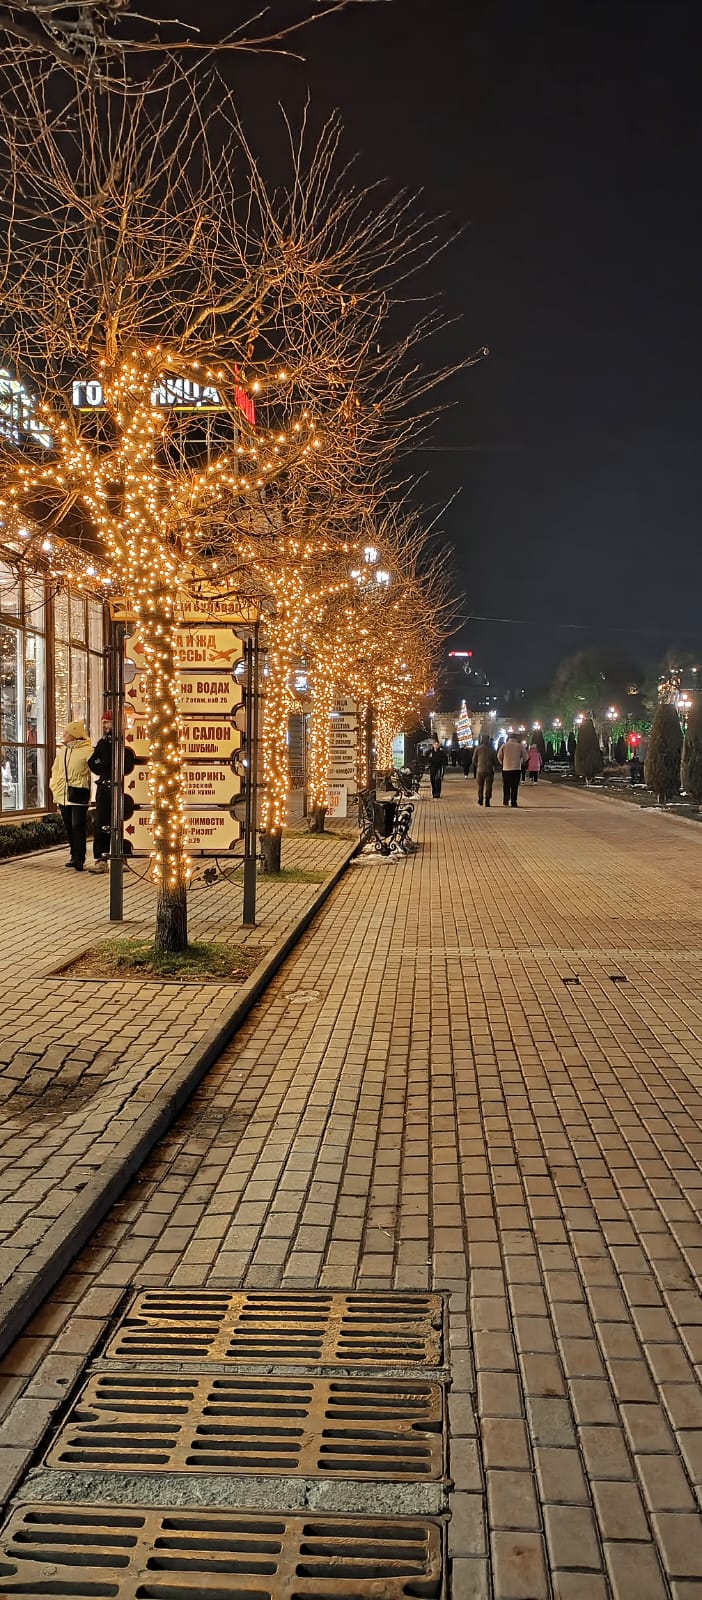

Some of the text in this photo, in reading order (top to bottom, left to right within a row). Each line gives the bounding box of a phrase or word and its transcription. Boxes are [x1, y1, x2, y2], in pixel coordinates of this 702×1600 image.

[196, 634, 217, 649] ЖД
[181, 681, 230, 695] на ВОДАХ
[193, 726, 231, 741] САЛОН
